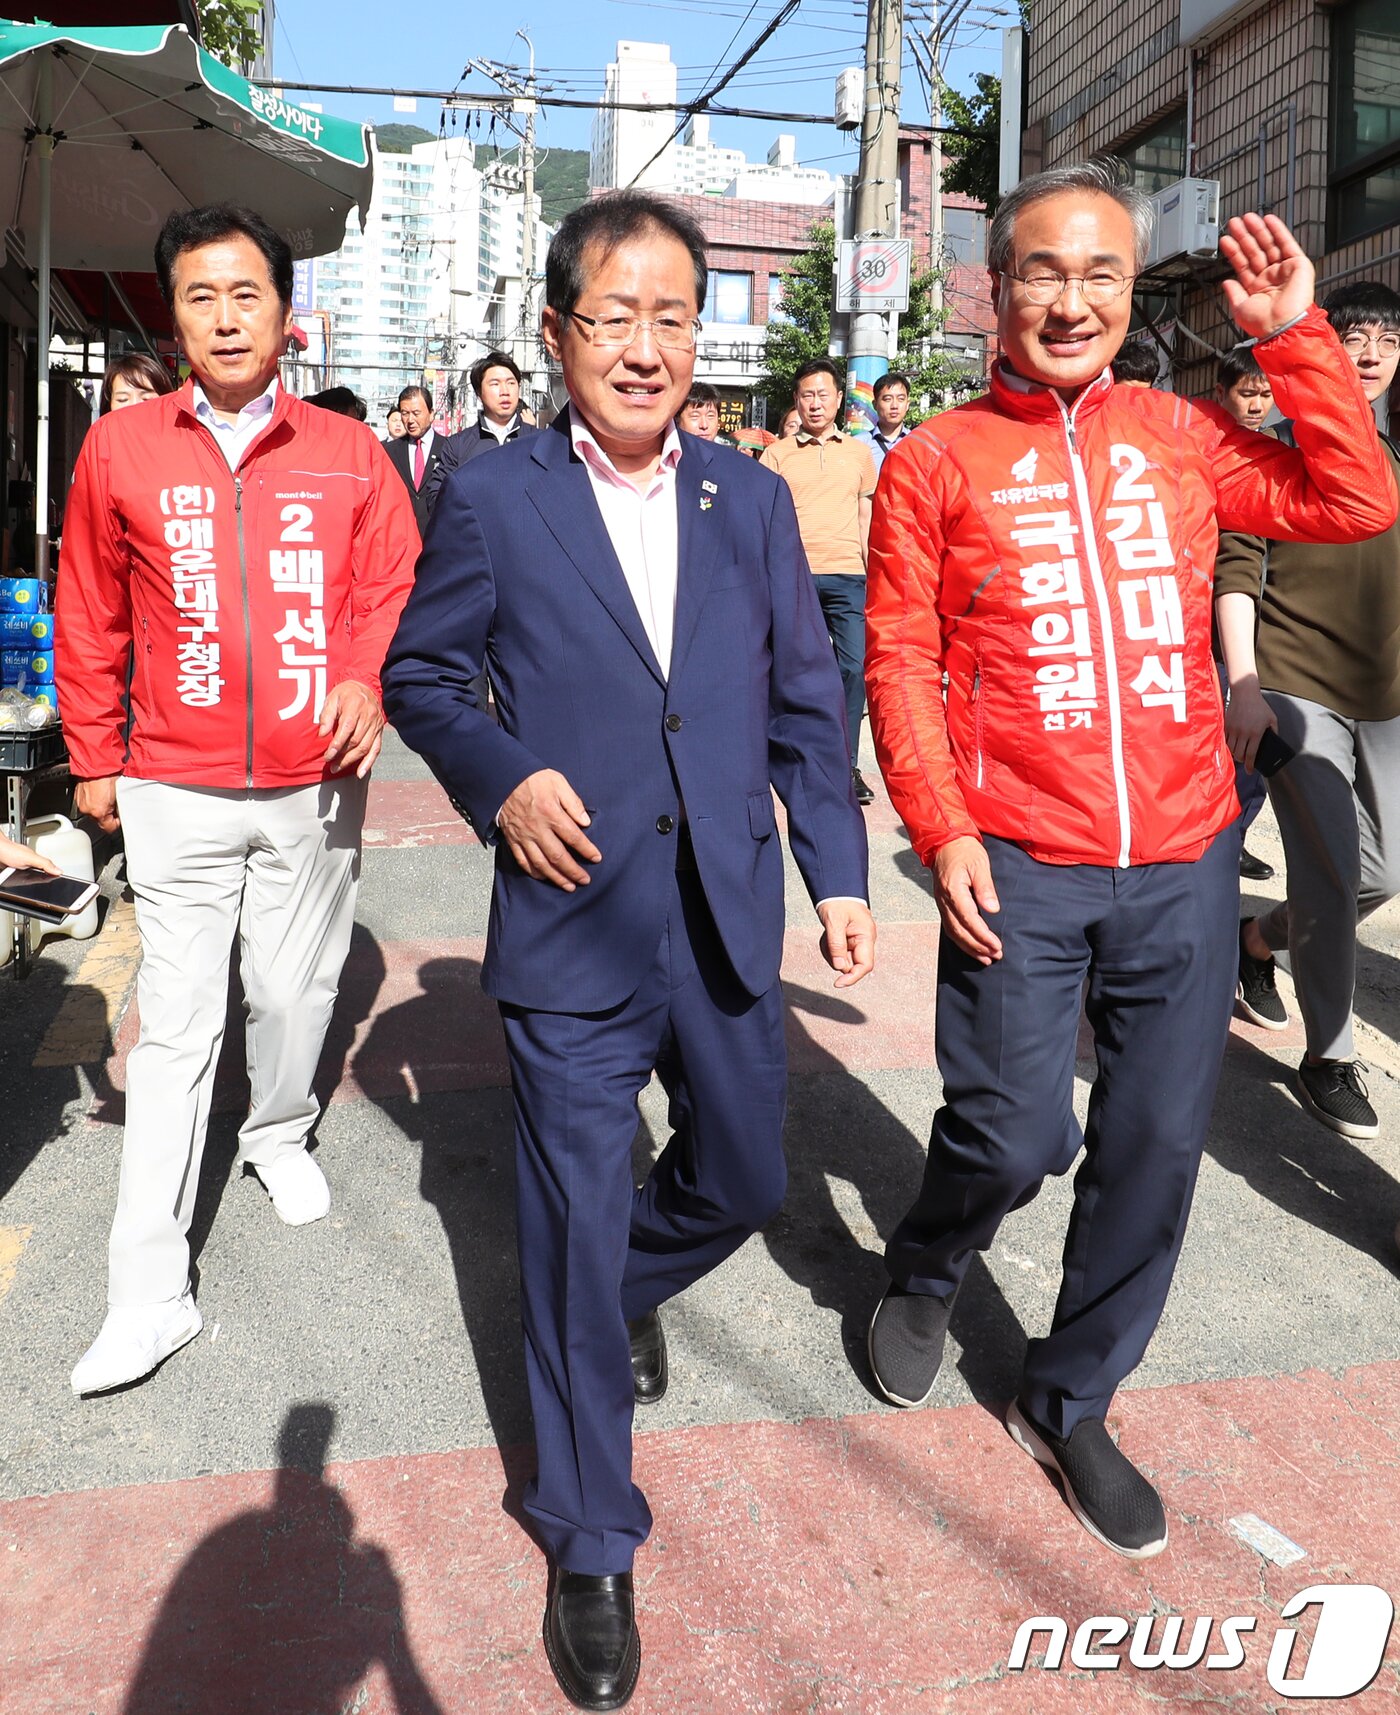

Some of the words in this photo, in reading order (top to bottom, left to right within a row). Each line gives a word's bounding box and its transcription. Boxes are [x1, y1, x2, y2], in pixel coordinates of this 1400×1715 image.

[248, 84, 324, 140] 칠성사이다
[861, 259, 886, 279] 30
[990, 482, 1070, 506] 자유한국당
[1109, 443, 1157, 501] 2
[280, 504, 314, 542] 2
[269, 550, 328, 724] 백선기
[1010, 510, 1099, 711] 국회의원
[1105, 502, 1187, 723] 김대식
[1042, 711, 1093, 731] 선거
